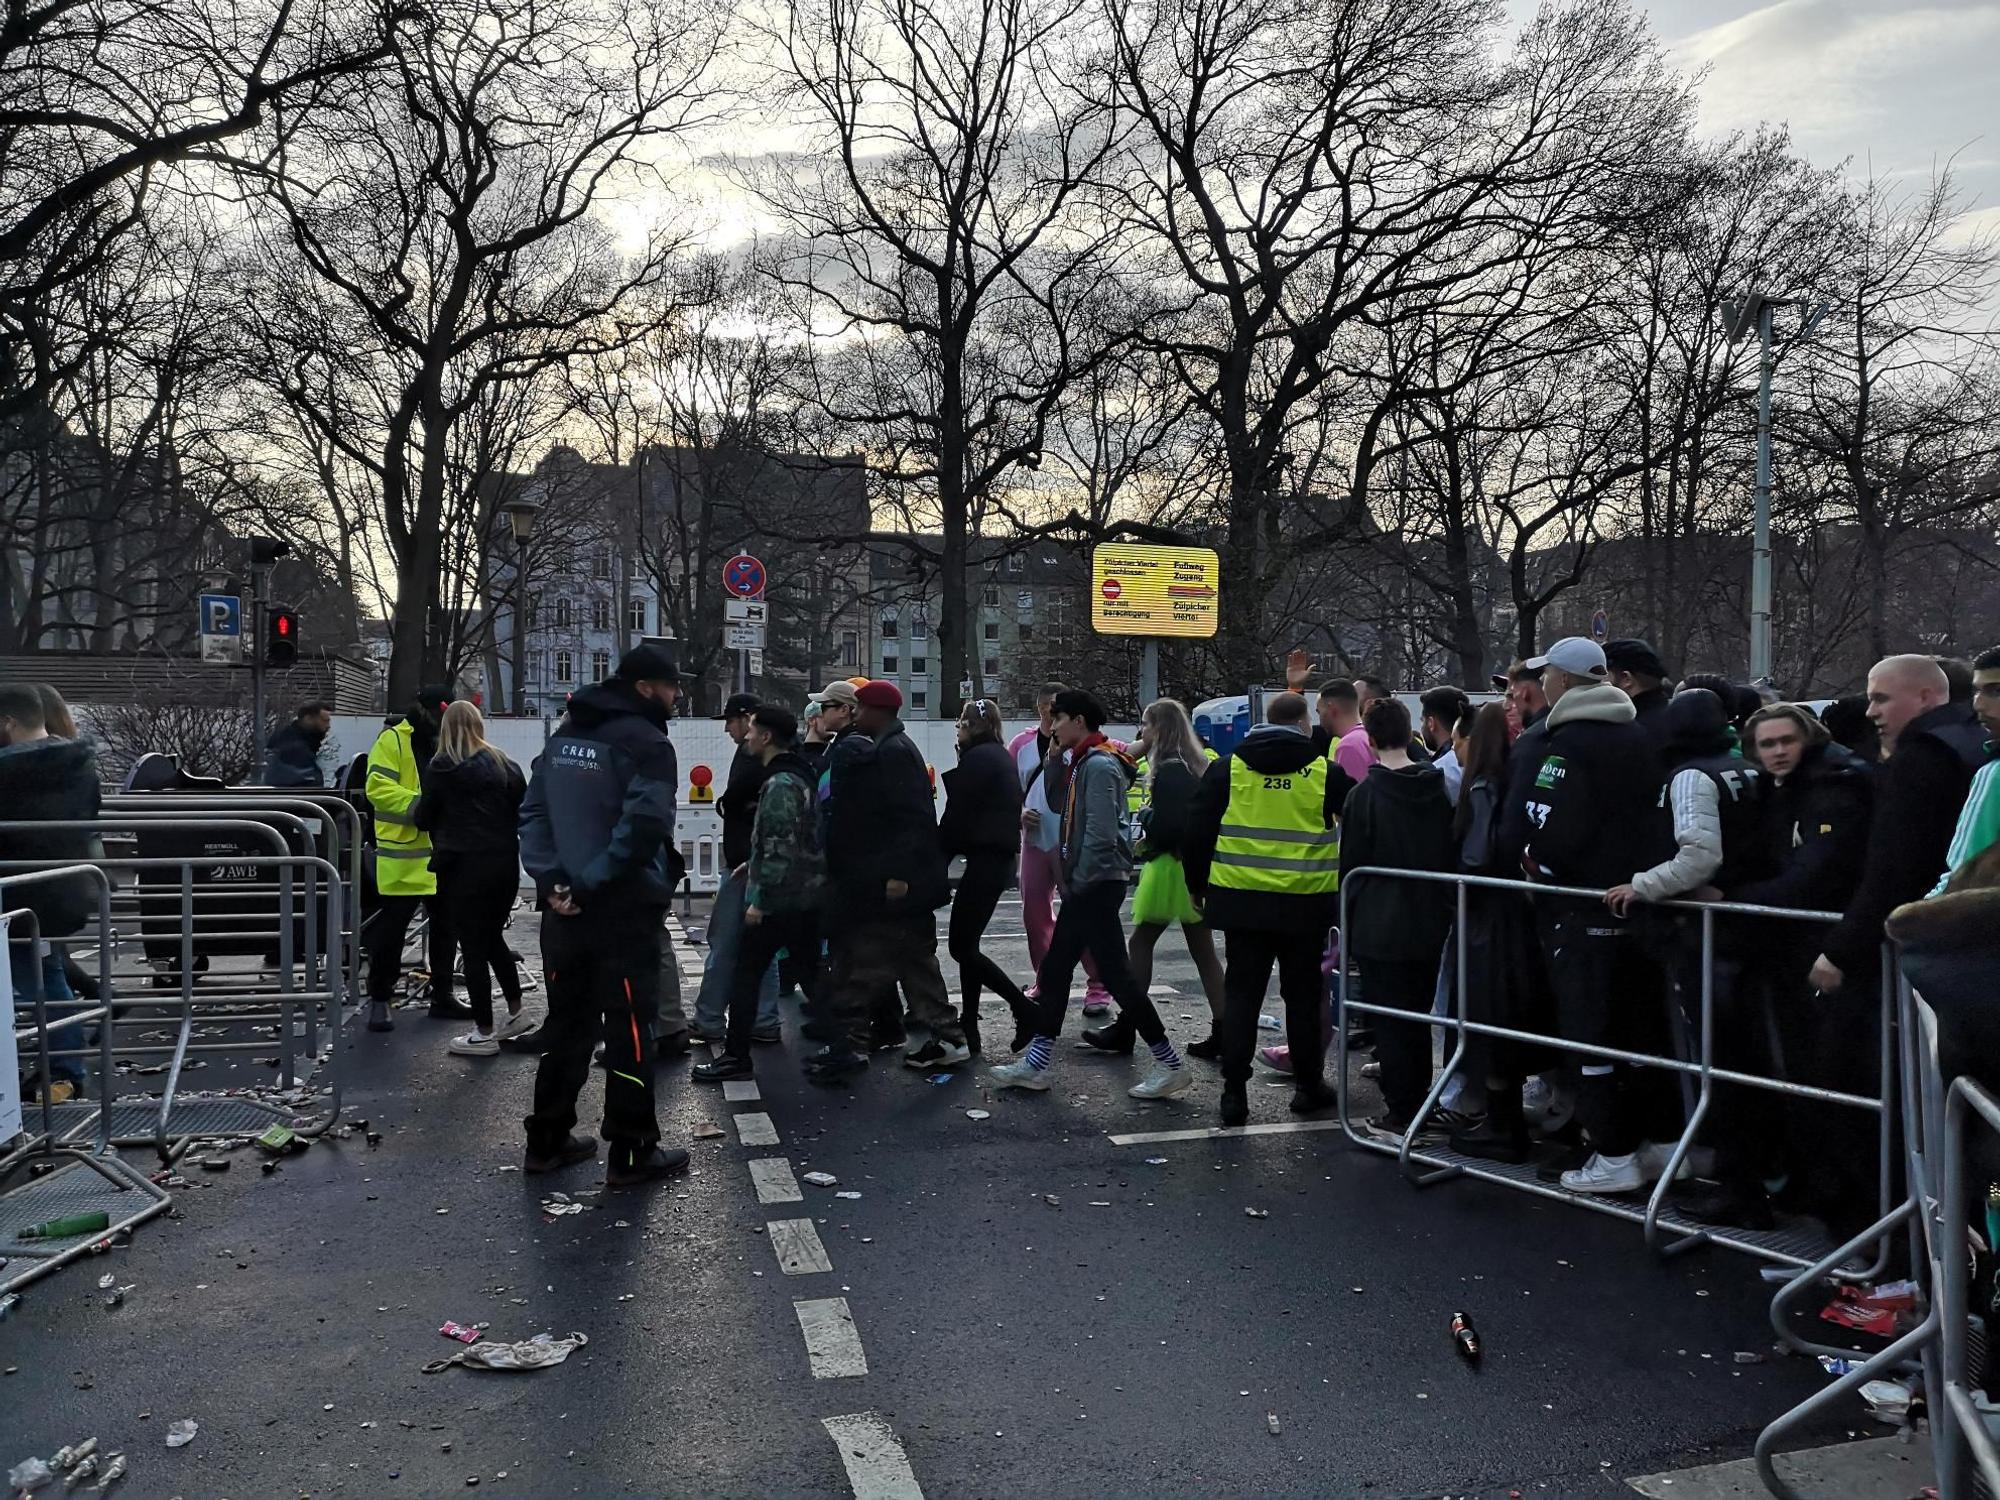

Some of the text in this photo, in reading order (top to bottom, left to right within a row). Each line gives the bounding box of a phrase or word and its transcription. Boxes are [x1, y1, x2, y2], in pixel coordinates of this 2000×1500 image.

[1173, 573, 1204, 582] Zugang
[210, 601, 231, 631] P
[562, 745, 597, 758] CREW
[1263, 777, 1292, 790] 238
[227, 866, 257, 877] AWB
